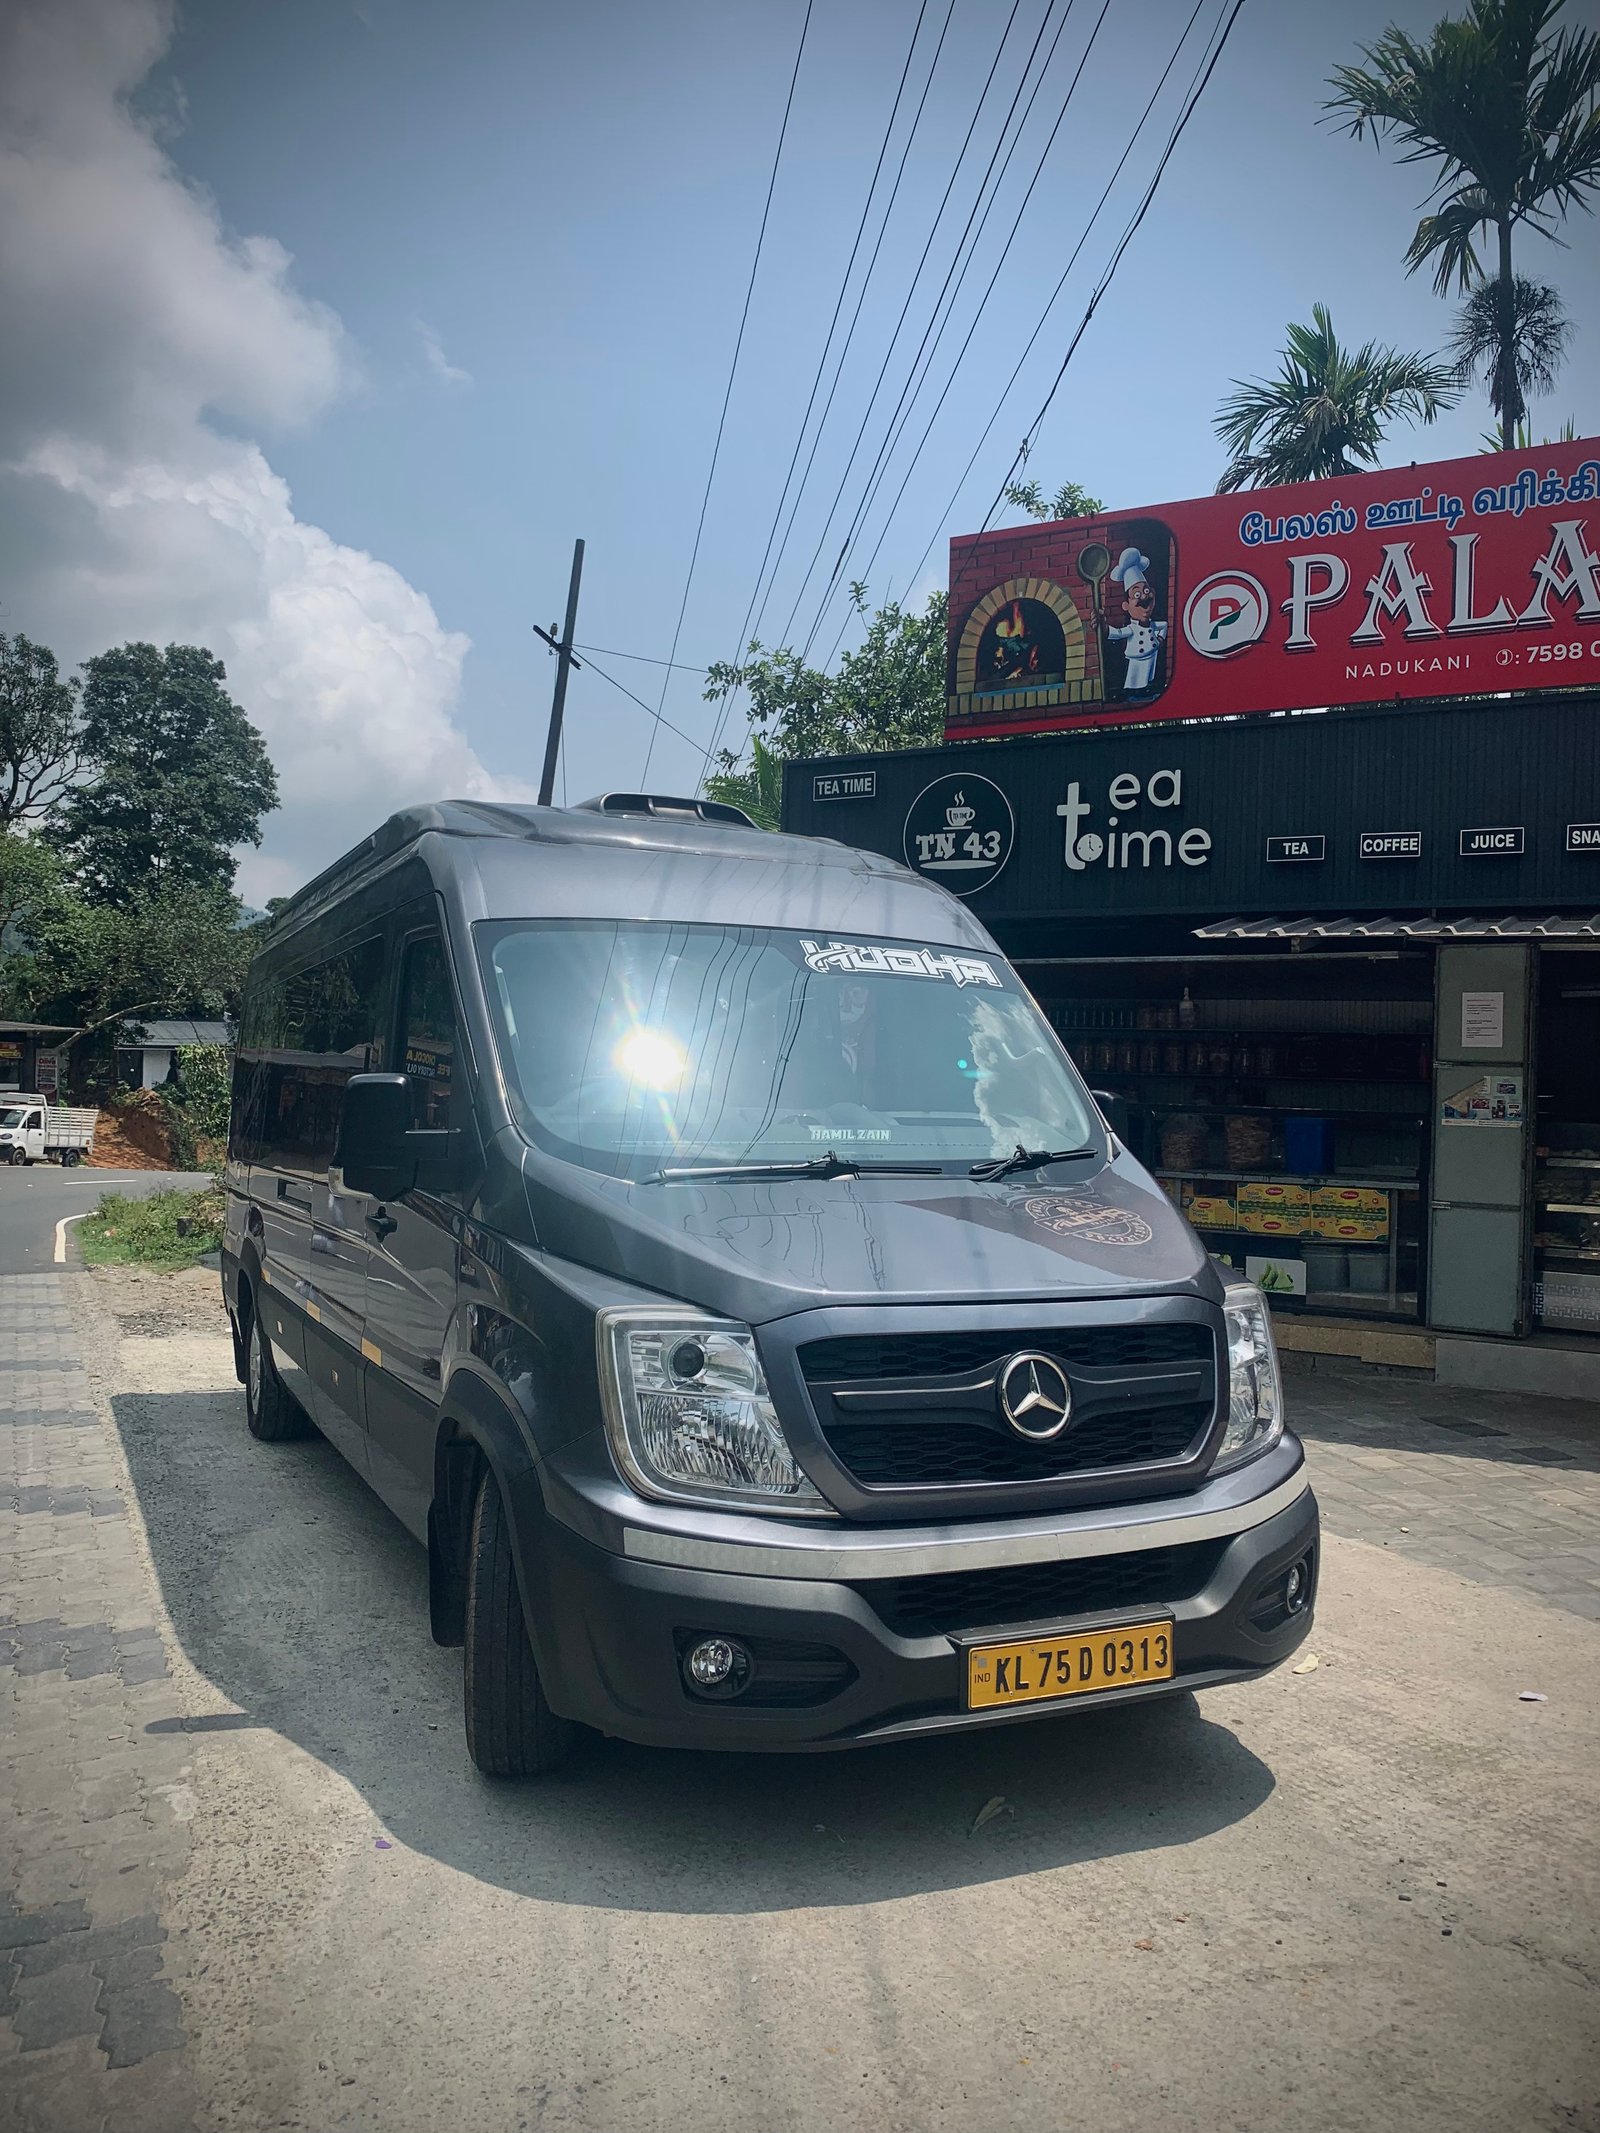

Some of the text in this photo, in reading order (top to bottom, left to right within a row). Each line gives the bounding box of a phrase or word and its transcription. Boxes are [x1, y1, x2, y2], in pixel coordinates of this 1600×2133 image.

[1240, 501, 1357, 546] பேலஸ்
[1366, 487, 1465, 531] ஊட்டி
[1527, 642, 1583, 664] 7598
[1345, 654, 1470, 679] NADUKANI
[817, 777, 873, 796] TEA TIME
[916, 831, 1001, 861] TN 43
[1283, 841, 1309, 855] TEA
[1363, 837, 1419, 853] COFFEE
[1470, 833, 1515, 850] JUICE
[857, 1129, 891, 1141] ZAIN
[974, 1635, 1168, 1693] IND KL 75 D 0313
